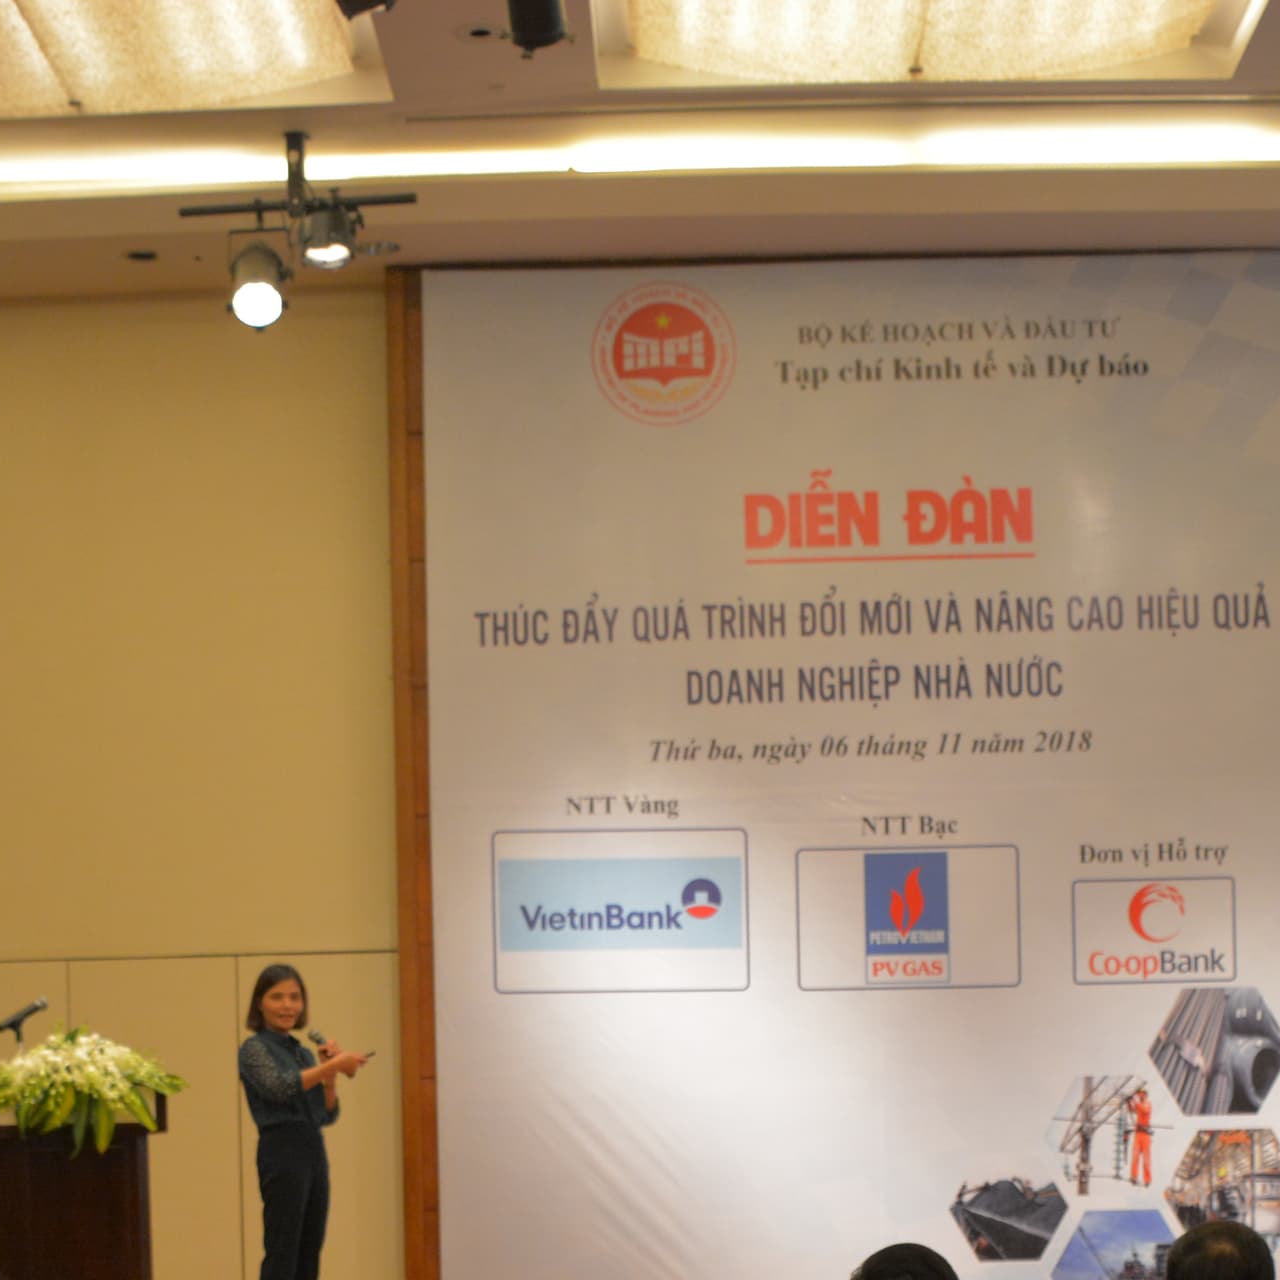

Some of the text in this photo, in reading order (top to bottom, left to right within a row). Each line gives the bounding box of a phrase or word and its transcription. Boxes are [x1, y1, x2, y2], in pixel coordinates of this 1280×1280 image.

[883, 321, 974, 347] HOẠCH
[982, 314, 1017, 340] VÀ
[774, 349, 1150, 391] Tạp chí Kinh tế và Dự báo
[743, 468, 1034, 549] DIỄN ĐÀN
[474, 581, 1272, 648] THÚC ĐẨY QUÁ TRÌNH ĐỔI MỚI VÀ NÂNG CAO HIỆU QUẢ
[686, 653, 1064, 709] DOANH NGHIỆP NHÀ NƯỚC
[649, 729, 1093, 766] Thứ ba, ngày 06 tháng 11 năm 2018
[566, 793, 681, 820] NTT Vàng
[860, 815, 959, 840] NTT Bạc
[1079, 836, 1230, 868] Đơn vị Hỗ trợ
[520, 903, 684, 932] VietinBank
[902, 958, 945, 977] GAS
